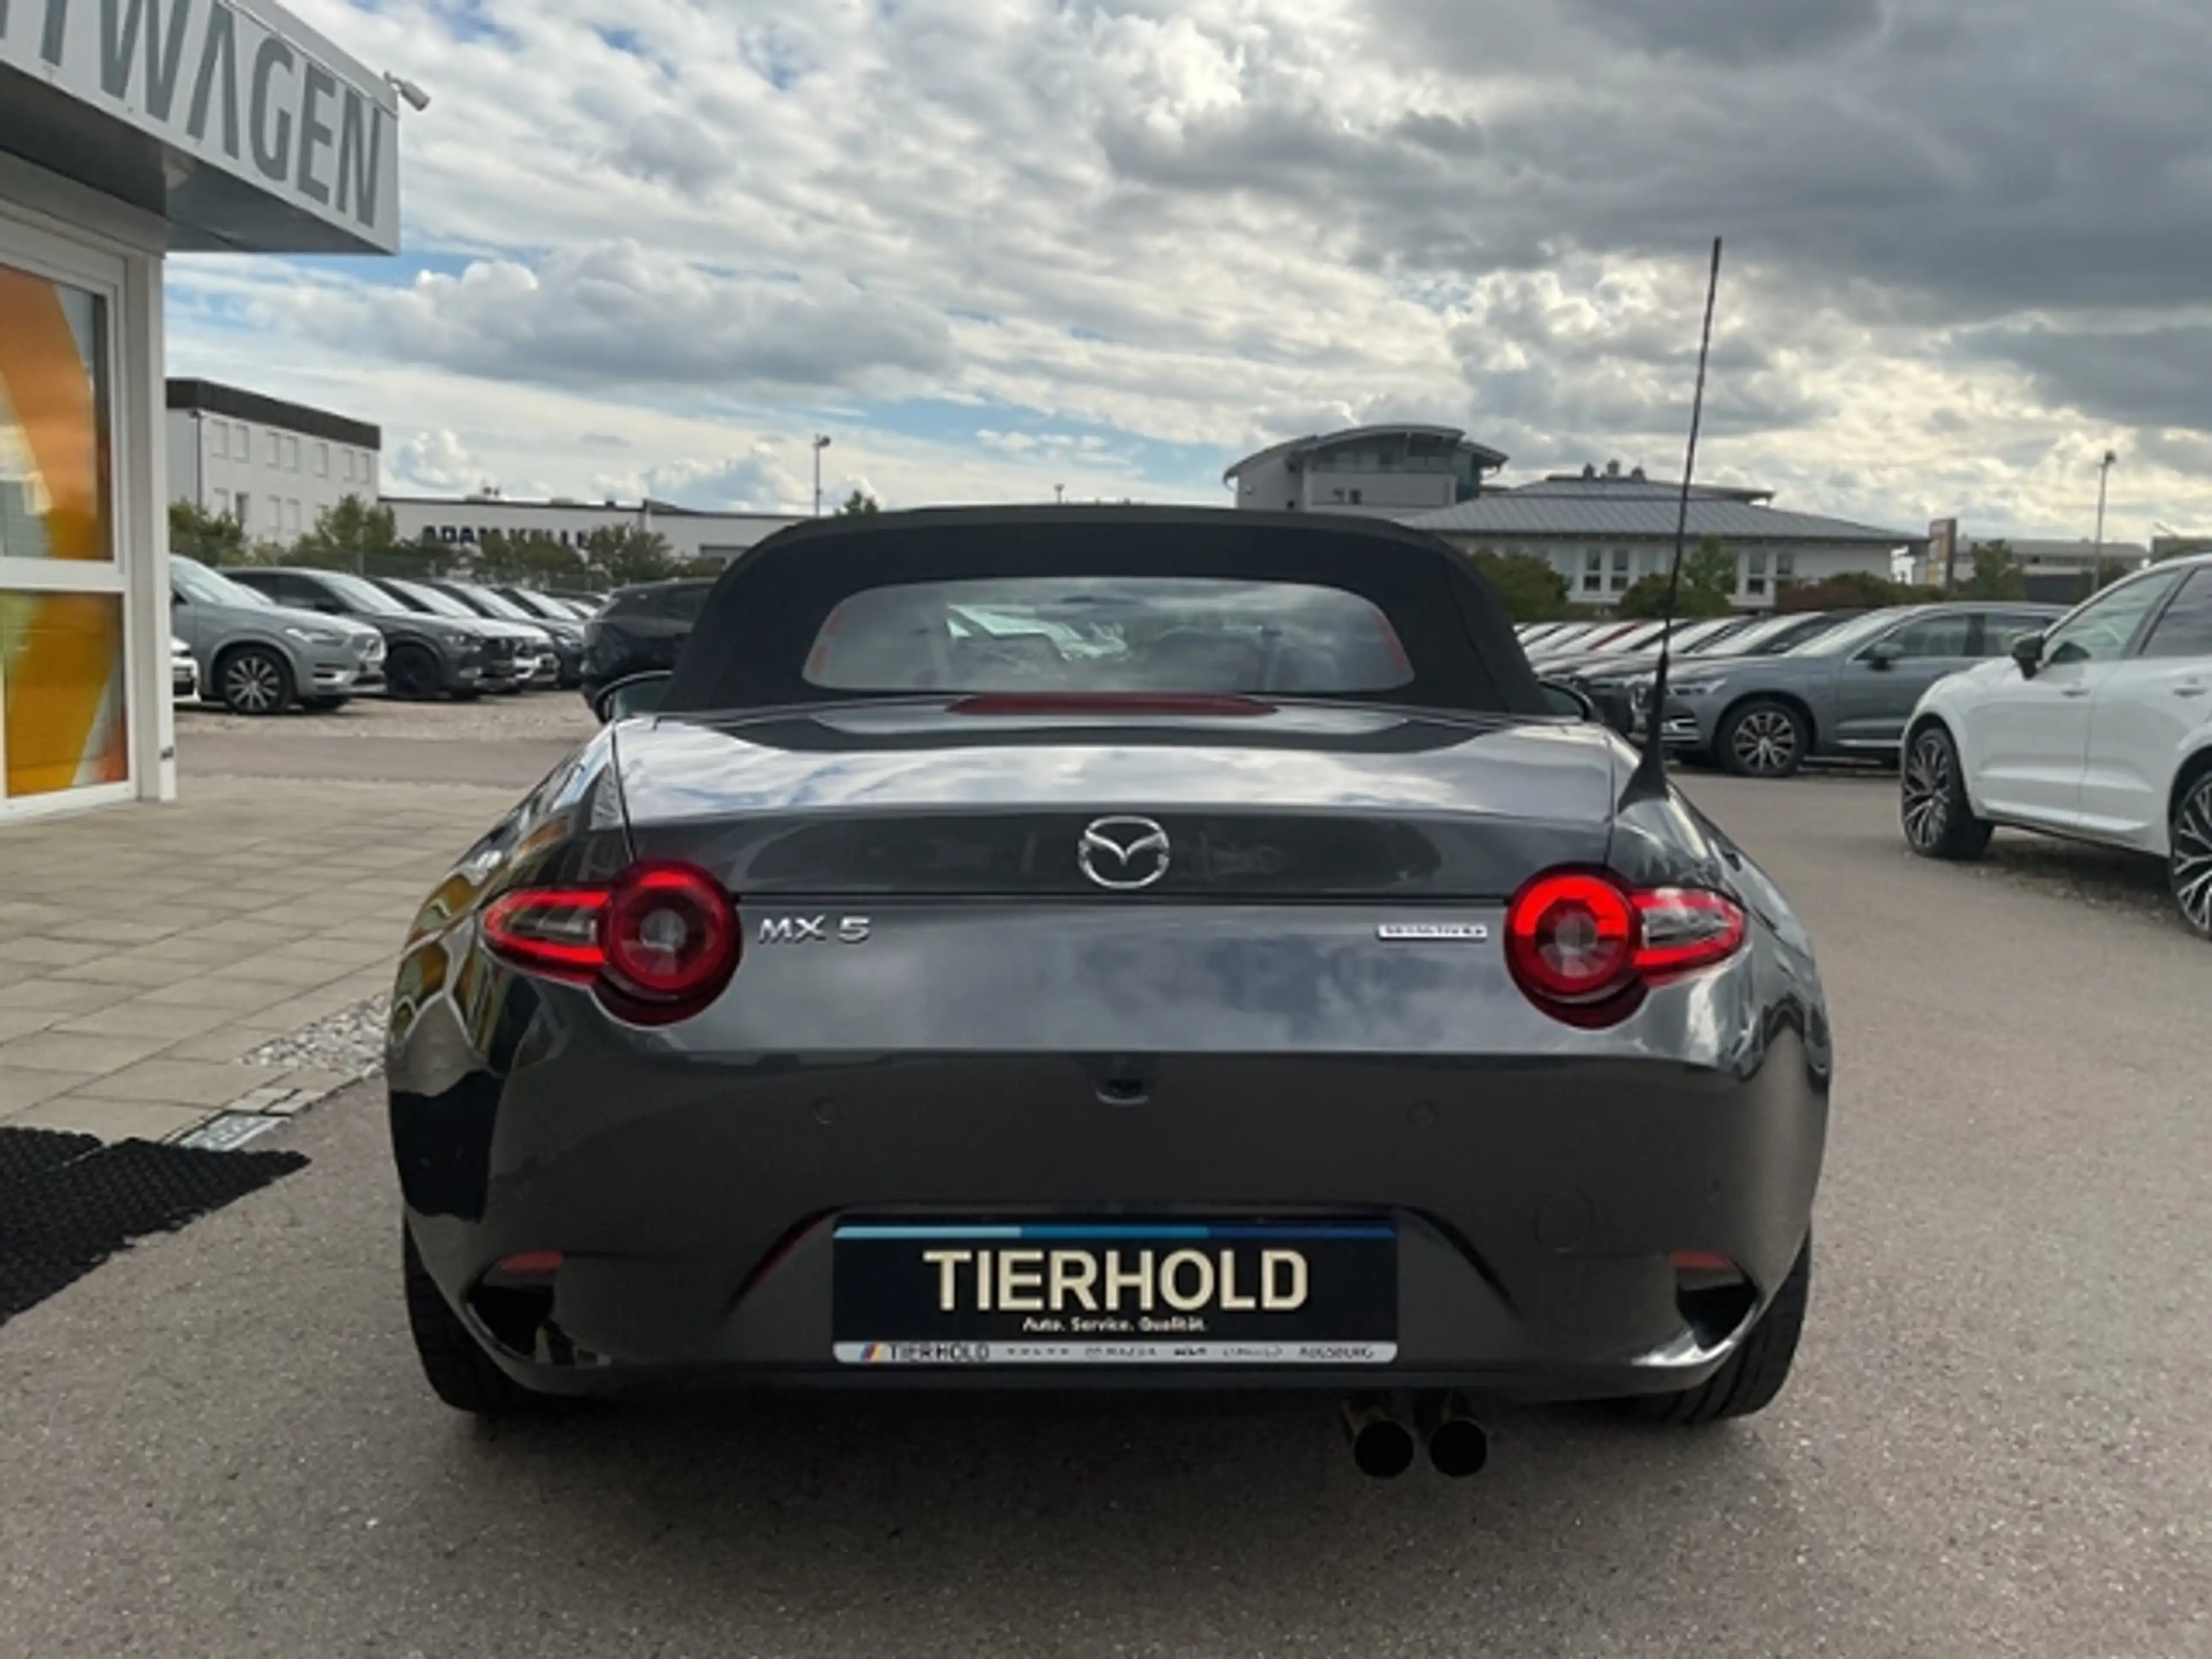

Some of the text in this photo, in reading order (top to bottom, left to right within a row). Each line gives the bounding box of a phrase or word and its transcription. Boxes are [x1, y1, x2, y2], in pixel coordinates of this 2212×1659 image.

[758, 914, 870, 944] MX 5
[923, 1249, 1309, 1312] TIERHOLD
[1022, 1316, 1065, 1332] Auto.
[1071, 1316, 1135, 1332] Service.
[888, 1342, 990, 1363] TIERHOLD
